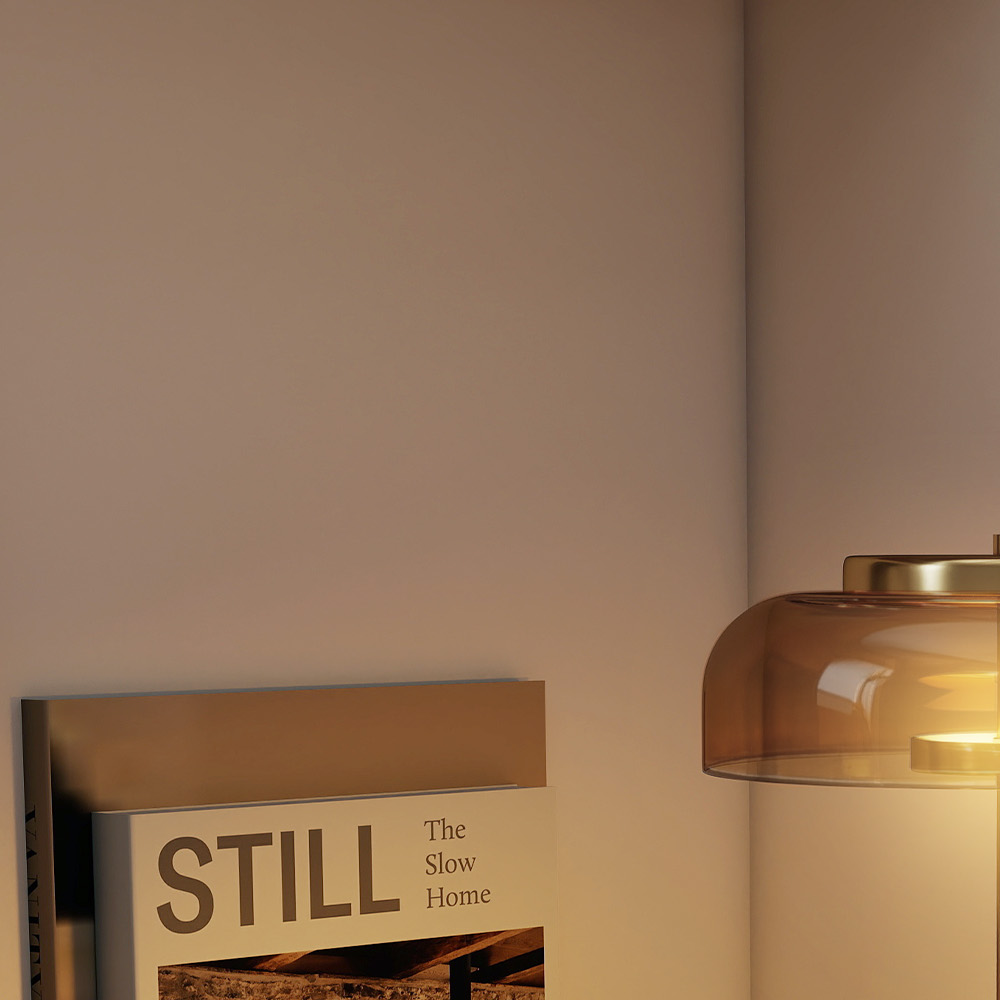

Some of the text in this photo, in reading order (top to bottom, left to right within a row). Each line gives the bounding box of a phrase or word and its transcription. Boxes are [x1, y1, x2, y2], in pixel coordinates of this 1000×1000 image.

[423, 818, 466, 841] The
[425, 853, 477, 876] Slow
[156, 825, 401, 934] STILL
[426, 885, 492, 909] Home
